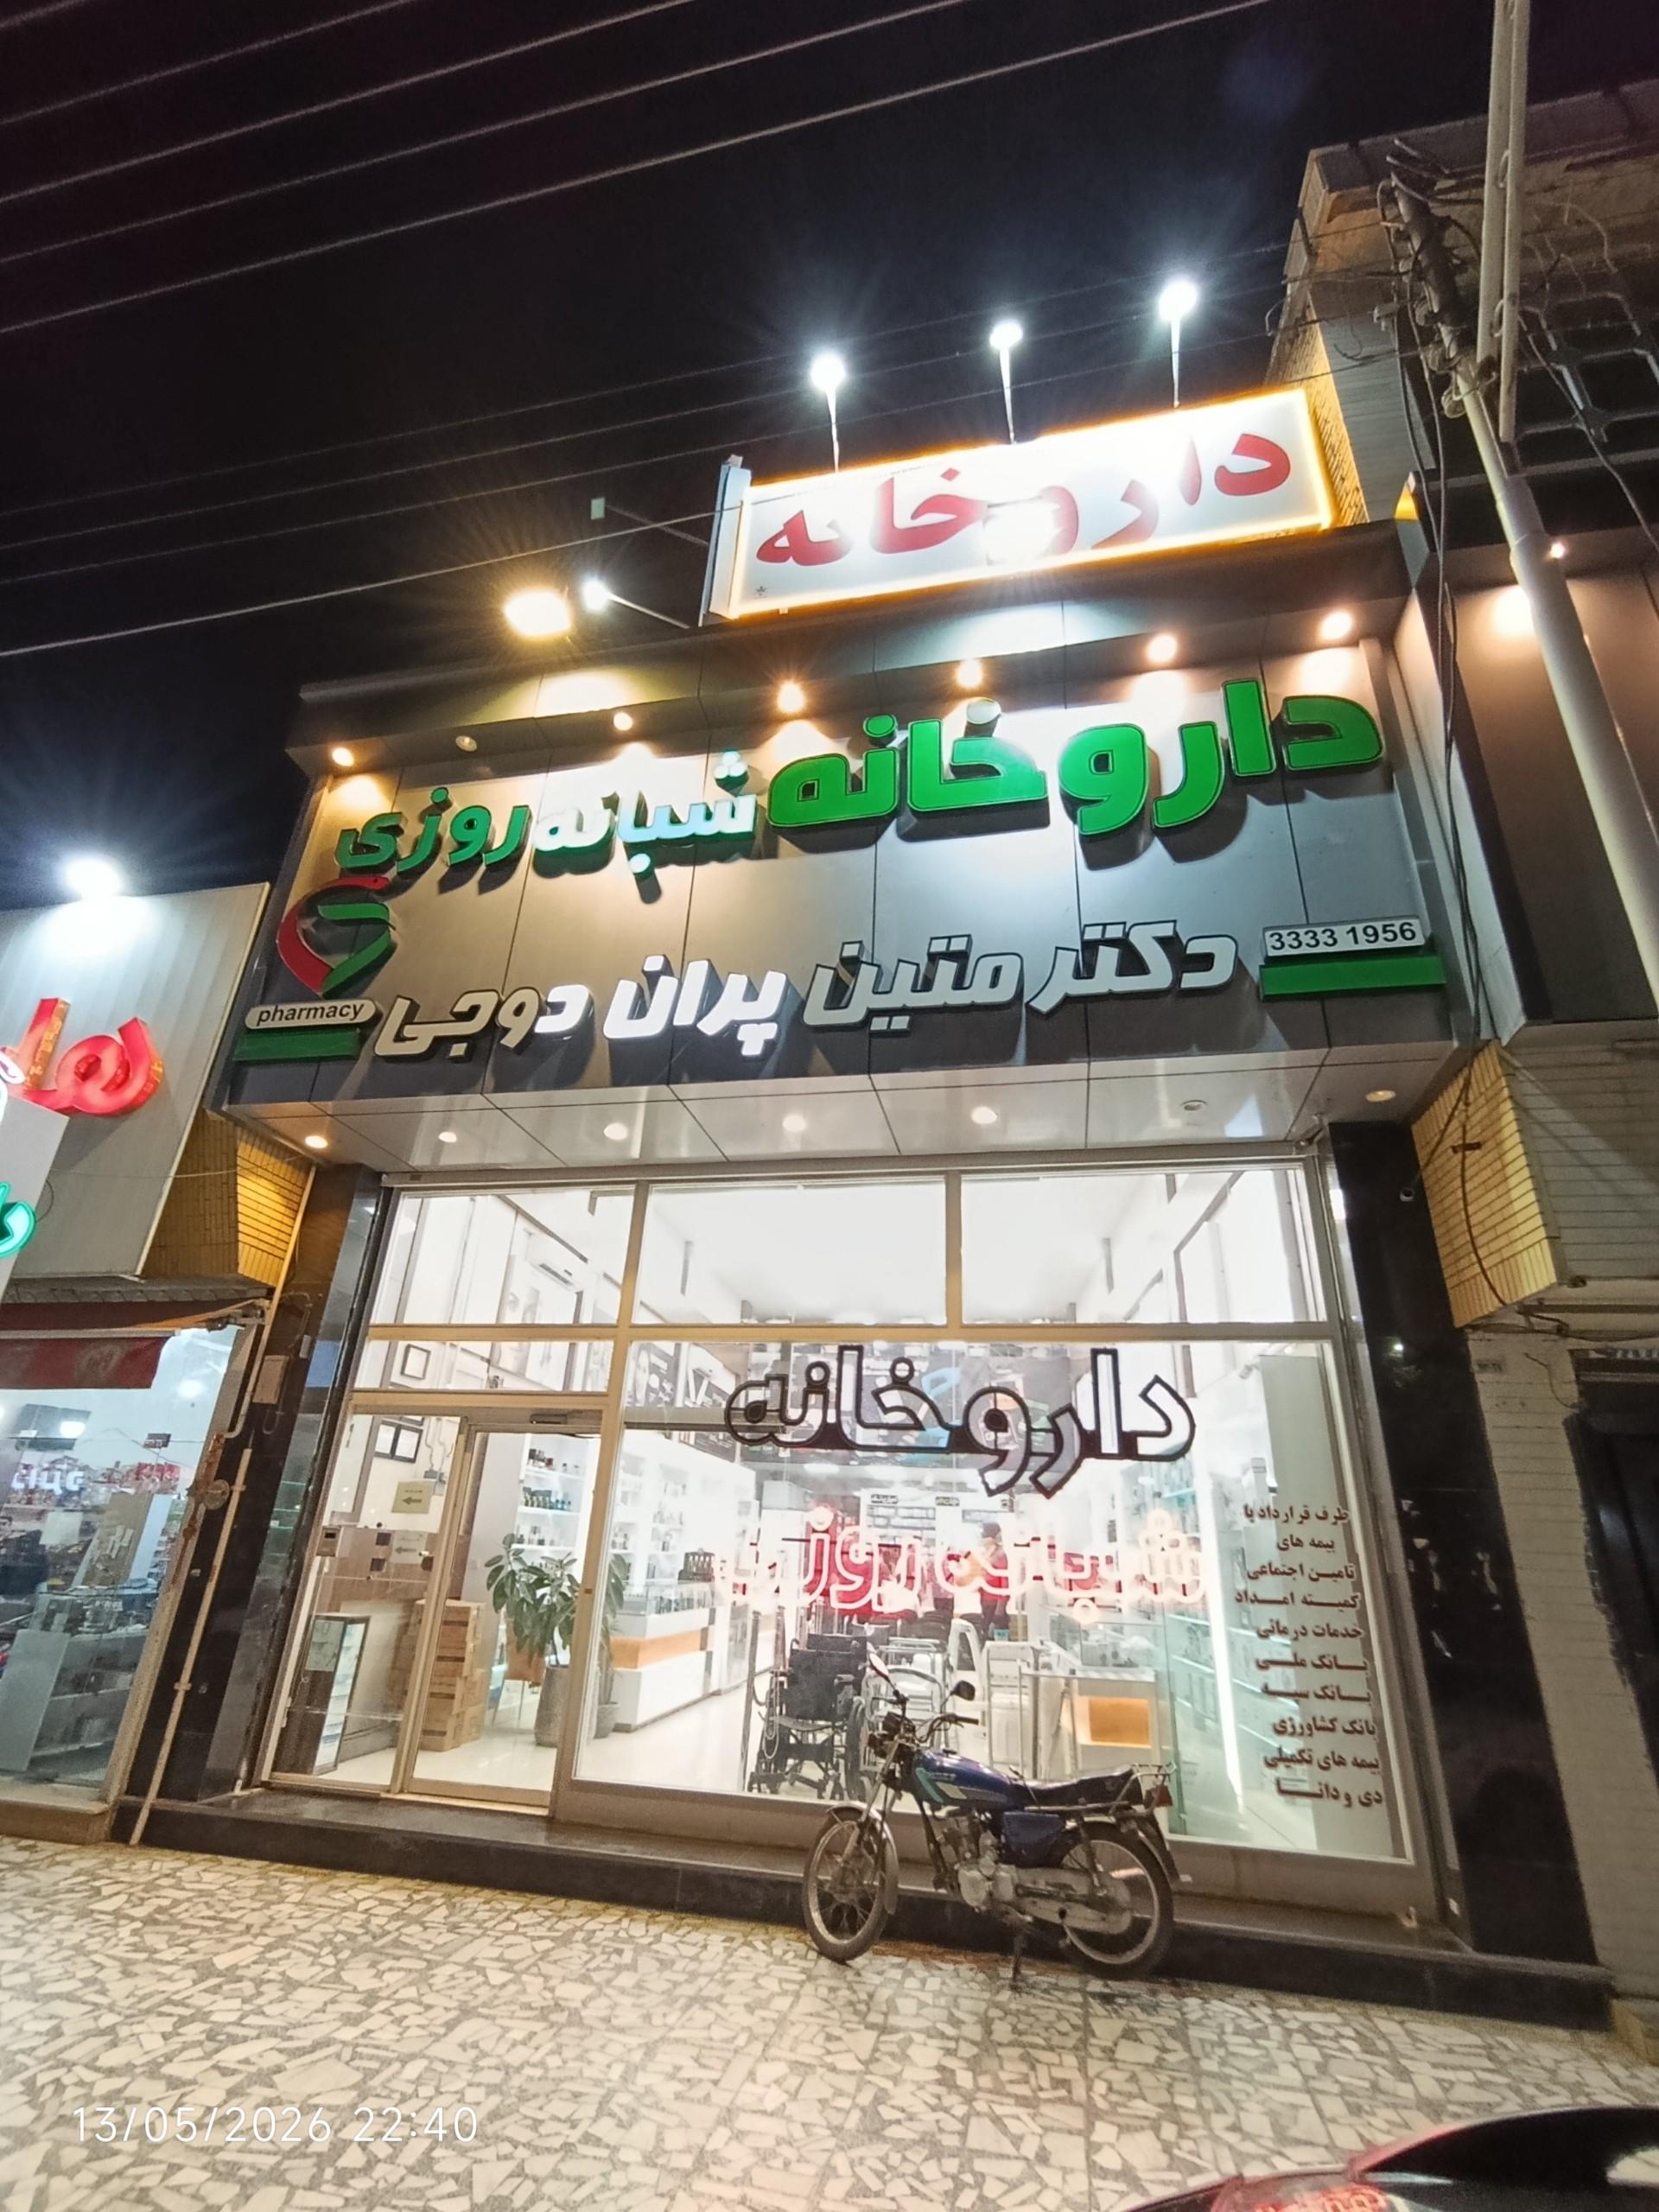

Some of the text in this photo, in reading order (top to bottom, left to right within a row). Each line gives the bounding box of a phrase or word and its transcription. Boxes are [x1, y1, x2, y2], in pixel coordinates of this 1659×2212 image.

[334, 678, 1384, 875] داروخانه شبانه روزی
[1268, 922, 1416, 950] 3333 1956
[803, 925, 1024, 1033] متین
[1026, 919, 1238, 1014] دکتر
[256, 1003, 365, 1027] pharmacy
[723, 1344, 1196, 1499] داروخانه
[1243, 1503, 1255, 1523] با
[1315, 1506, 1350, 1525] طرف
[1276, 1534, 1335, 1554] بیمه های
[712, 1504, 1207, 1625] شبانه روزی
[1247, 1561, 1355, 1582] تامین اجتماعی
[1235, 1589, 1360, 1613] کمیته امداد
[1256, 1618, 1363, 1641] خدمات درمانی
[1255, 1653, 1369, 1675] بانک ملی
[1313, 1684, 1371, 1707] بانک
[1272, 1714, 1376, 1740] بانک کشاورزی
[1263, 1745, 1381, 1775] بیمه های تکمیلی
[1275, 1777, 1383, 1808] دی و دانا
